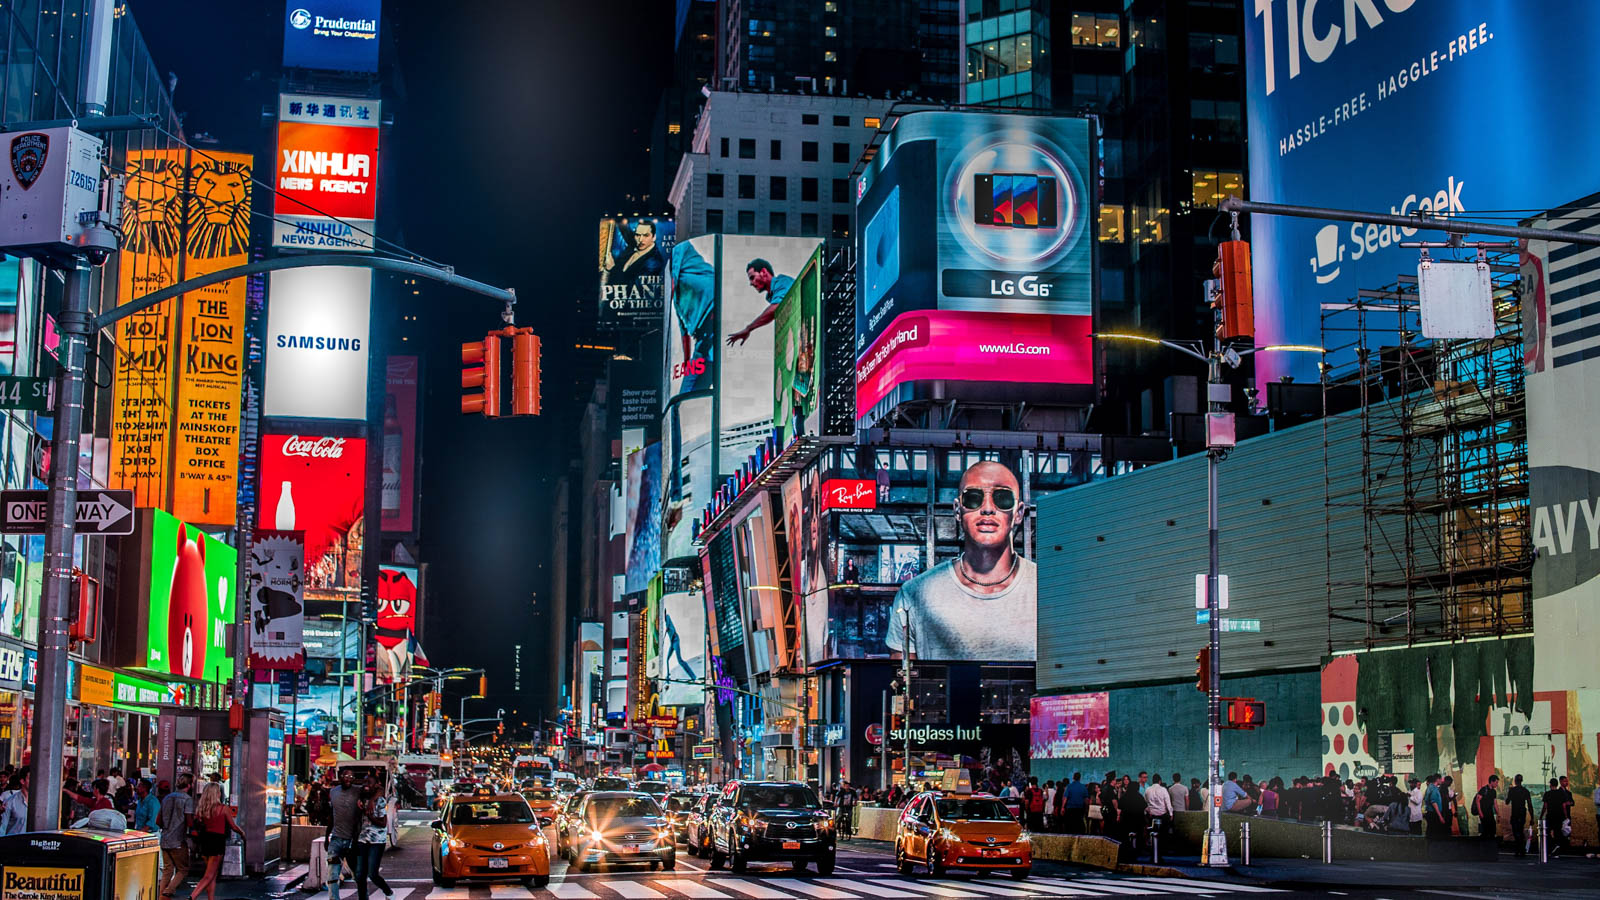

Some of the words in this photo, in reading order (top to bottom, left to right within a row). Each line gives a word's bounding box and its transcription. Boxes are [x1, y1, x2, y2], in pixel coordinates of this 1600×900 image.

[315, 16, 376, 31] Prudential
[1280, 93, 1372, 156] HASSLE-FREE.
[1378, 22, 1494, 101] HAGGLE-FREE.
[289, 102, 370, 119] 新华通讯社
[13, 143, 47, 154] DEPARTMENT
[282, 150, 370, 178] XINHUA
[70, 170, 97, 193] 726157
[280, 177, 313, 191] NEWS
[320, 179, 368, 194] AGENCY
[1351, 176, 1465, 260] SeatGeek
[296, 221, 353, 237] XINHUA
[282, 234, 315, 245] NEWS
[318, 237, 366, 248] AGENCY
[639, 275, 664, 284] THE
[990, 279, 1016, 295] LG
[197, 299, 228, 315] THE
[609, 299, 626, 309] OF
[628, 300, 652, 308] THE
[191, 316, 233, 342] LION
[277, 335, 361, 351] SAMSUNG
[979, 343, 1050, 355] www.LG.com
[185, 344, 238, 374] KING
[32, 382, 47, 397] St
[641, 390, 657, 398] your
[189, 399, 231, 410] TICKETS
[628, 405, 648, 413] berry
[190, 411, 204, 420] AT
[208, 412, 228, 421] THE
[622, 413, 638, 421] good
[180, 422, 238, 434] MINSKOFF
[185, 434, 231, 446] THEATRE
[282, 434, 346, 458] Coca-Cola
[195, 446, 219, 457] BOX
[189, 458, 225, 469] OFFICE
[207, 473, 214, 481] &
[832, 482, 872, 505] Ray-Ban
[12, 504, 47, 520] ONE
[76, 504, 115, 521] WAY
[889, 724, 954, 744] sunglass
[956, 724, 983, 741] hut
[30, 839, 61, 847] BigBelly
[5, 872, 82, 892] Beautiful
[5, 892, 17, 900] The
[17, 892, 39, 900] Carole
